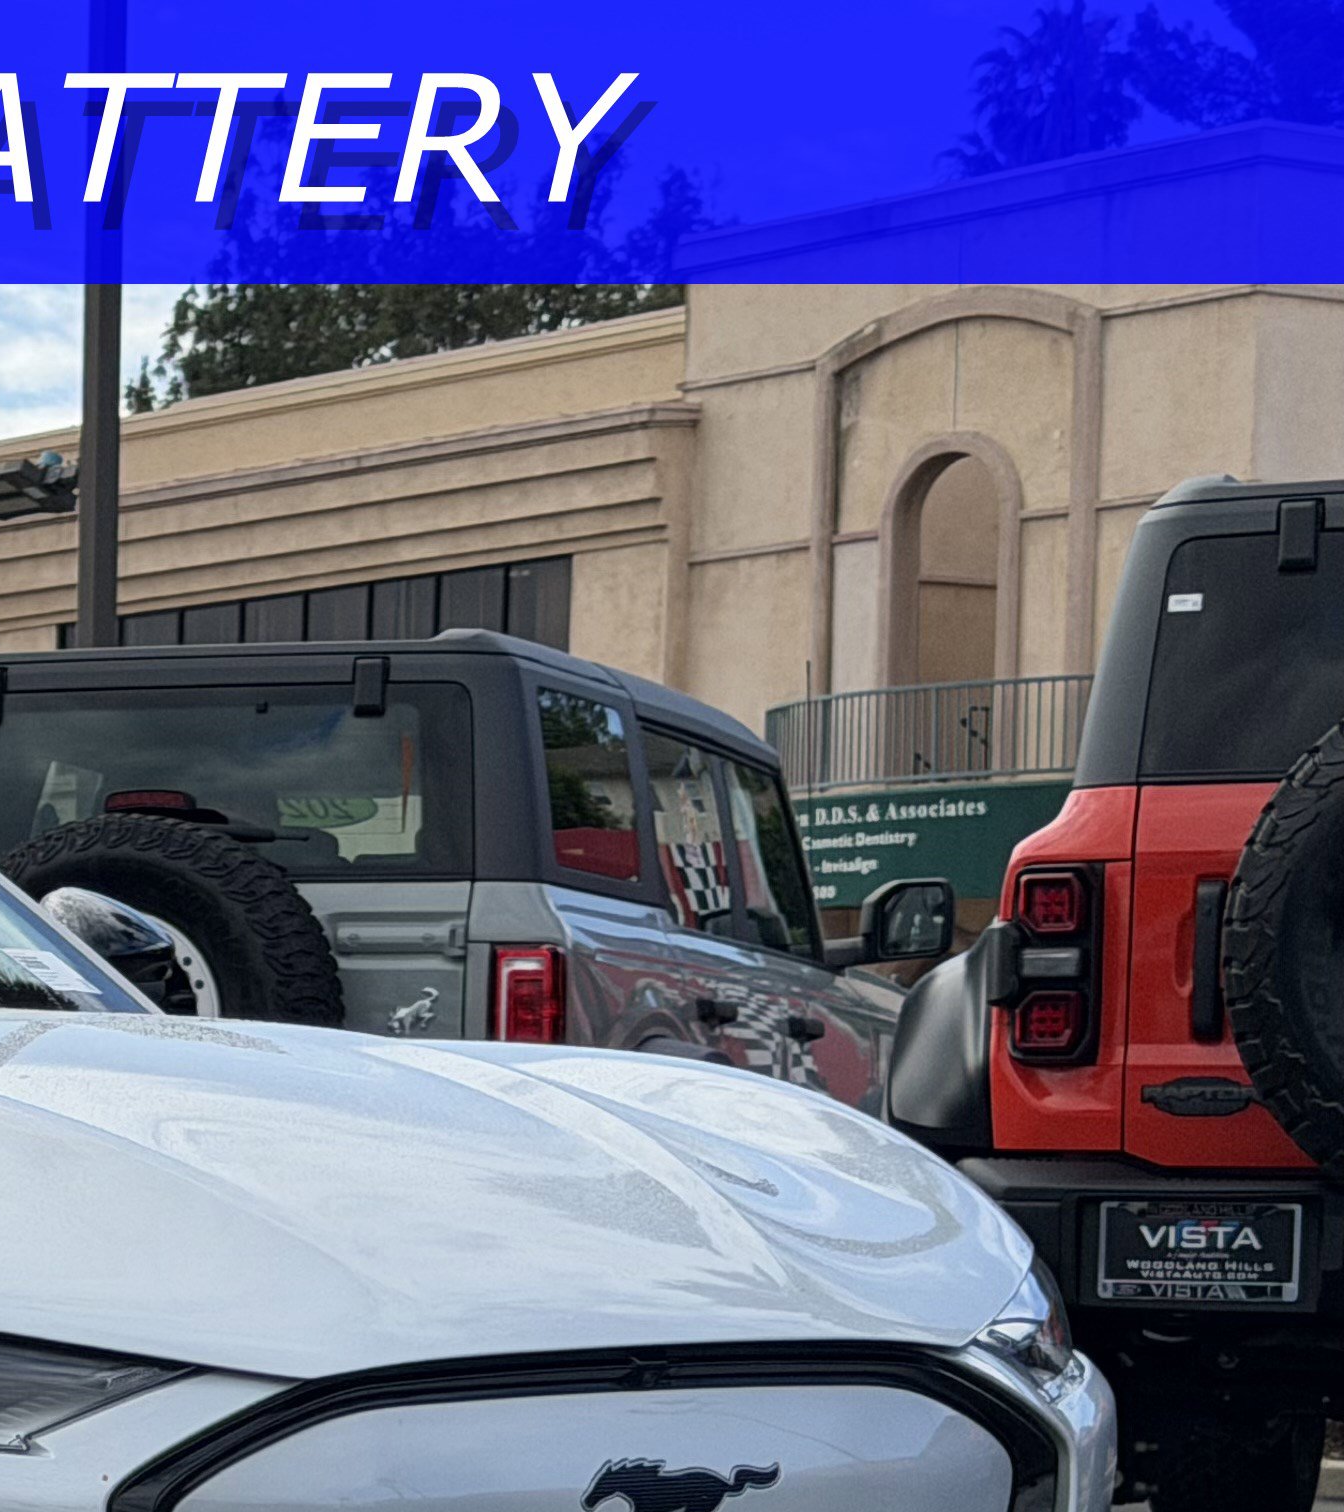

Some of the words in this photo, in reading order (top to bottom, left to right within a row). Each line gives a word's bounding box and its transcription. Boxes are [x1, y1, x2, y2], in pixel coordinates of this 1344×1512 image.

[814, 805, 863, 826] D.D.S.
[865, 803, 880, 823] &
[884, 798, 987, 822] Associates
[855, 831, 918, 848] Dentistry
[1139, 1225, 1262, 1250] VISTA
[1150, 1284, 1224, 1299] VISTA
